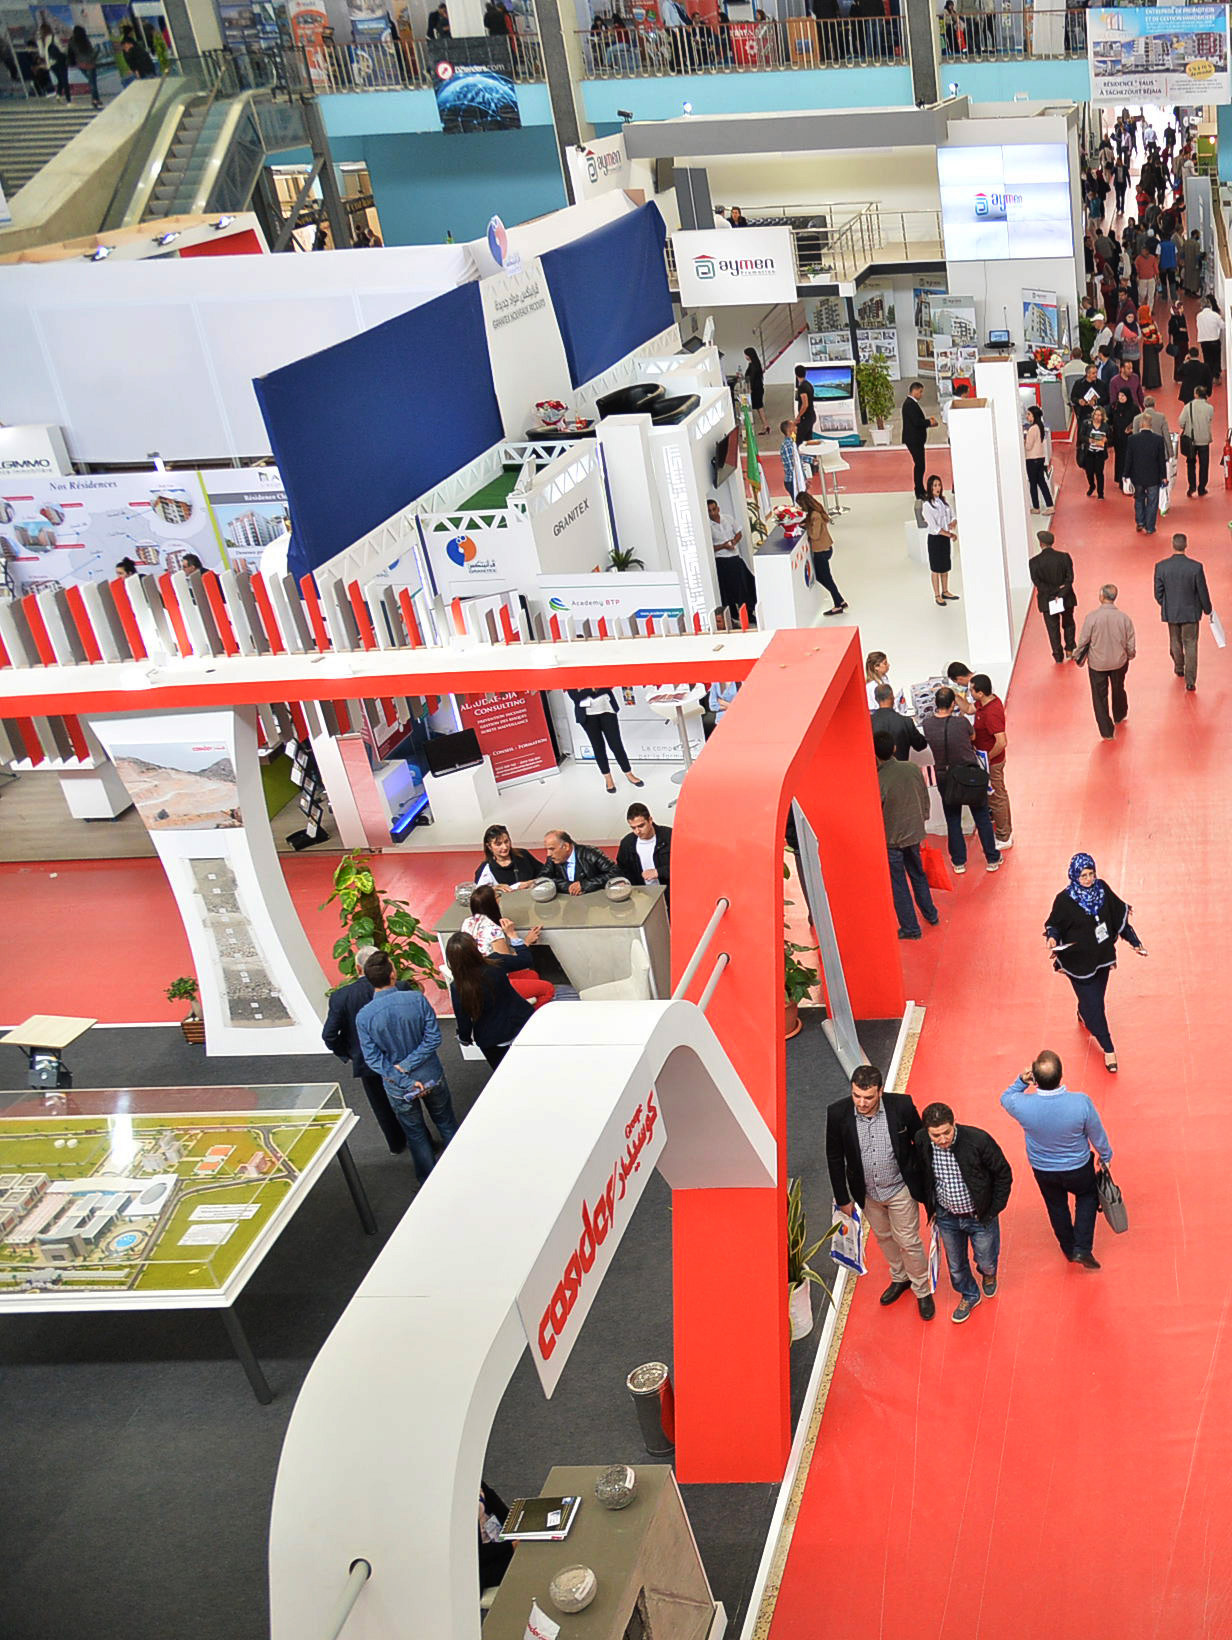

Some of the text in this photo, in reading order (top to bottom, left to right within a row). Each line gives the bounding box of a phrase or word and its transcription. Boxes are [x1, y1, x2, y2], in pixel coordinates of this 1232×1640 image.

[597, 150, 621, 176] aymen
[719, 258, 774, 276] aymen
[0, 459, 50, 469] GIMMO
[50, 480, 118, 491] Nos Résidences
[554, 498, 590, 536] GRANITEX
[474, 698, 526, 716] CONSULTING
